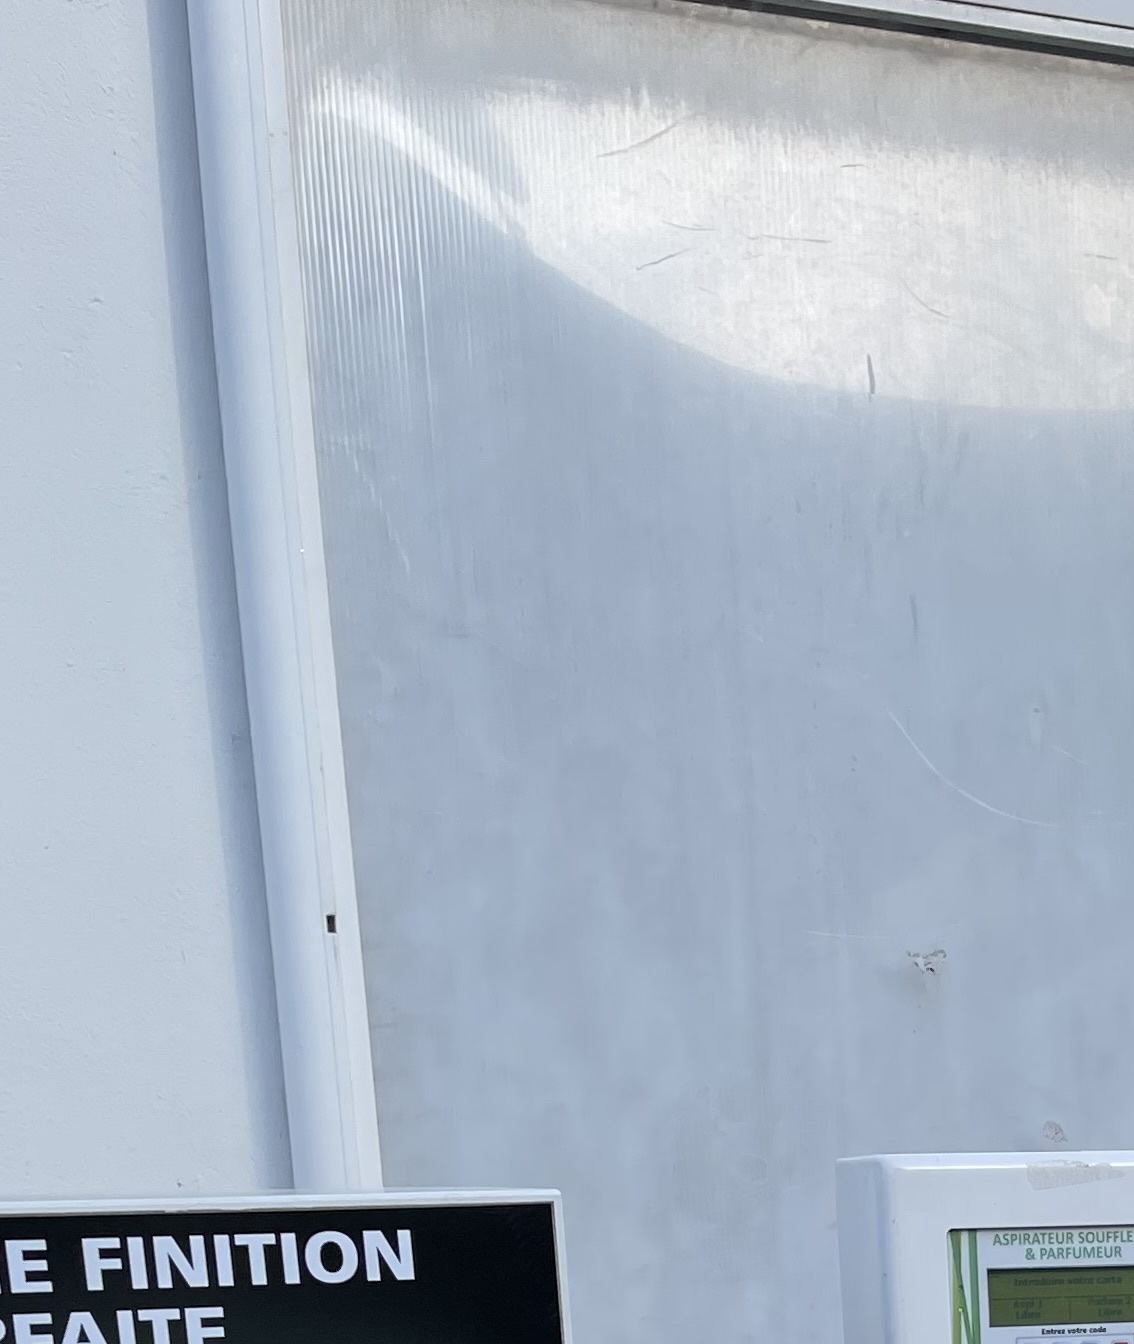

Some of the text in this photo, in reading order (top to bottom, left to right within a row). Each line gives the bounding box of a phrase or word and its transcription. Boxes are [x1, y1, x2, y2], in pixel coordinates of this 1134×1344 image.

[993, 1231, 1073, 1245] ASPIRATEUR
[1025, 1245, 1122, 1260] & PARFUMEUR
[0, 1230, 415, 1294] E FINITION
